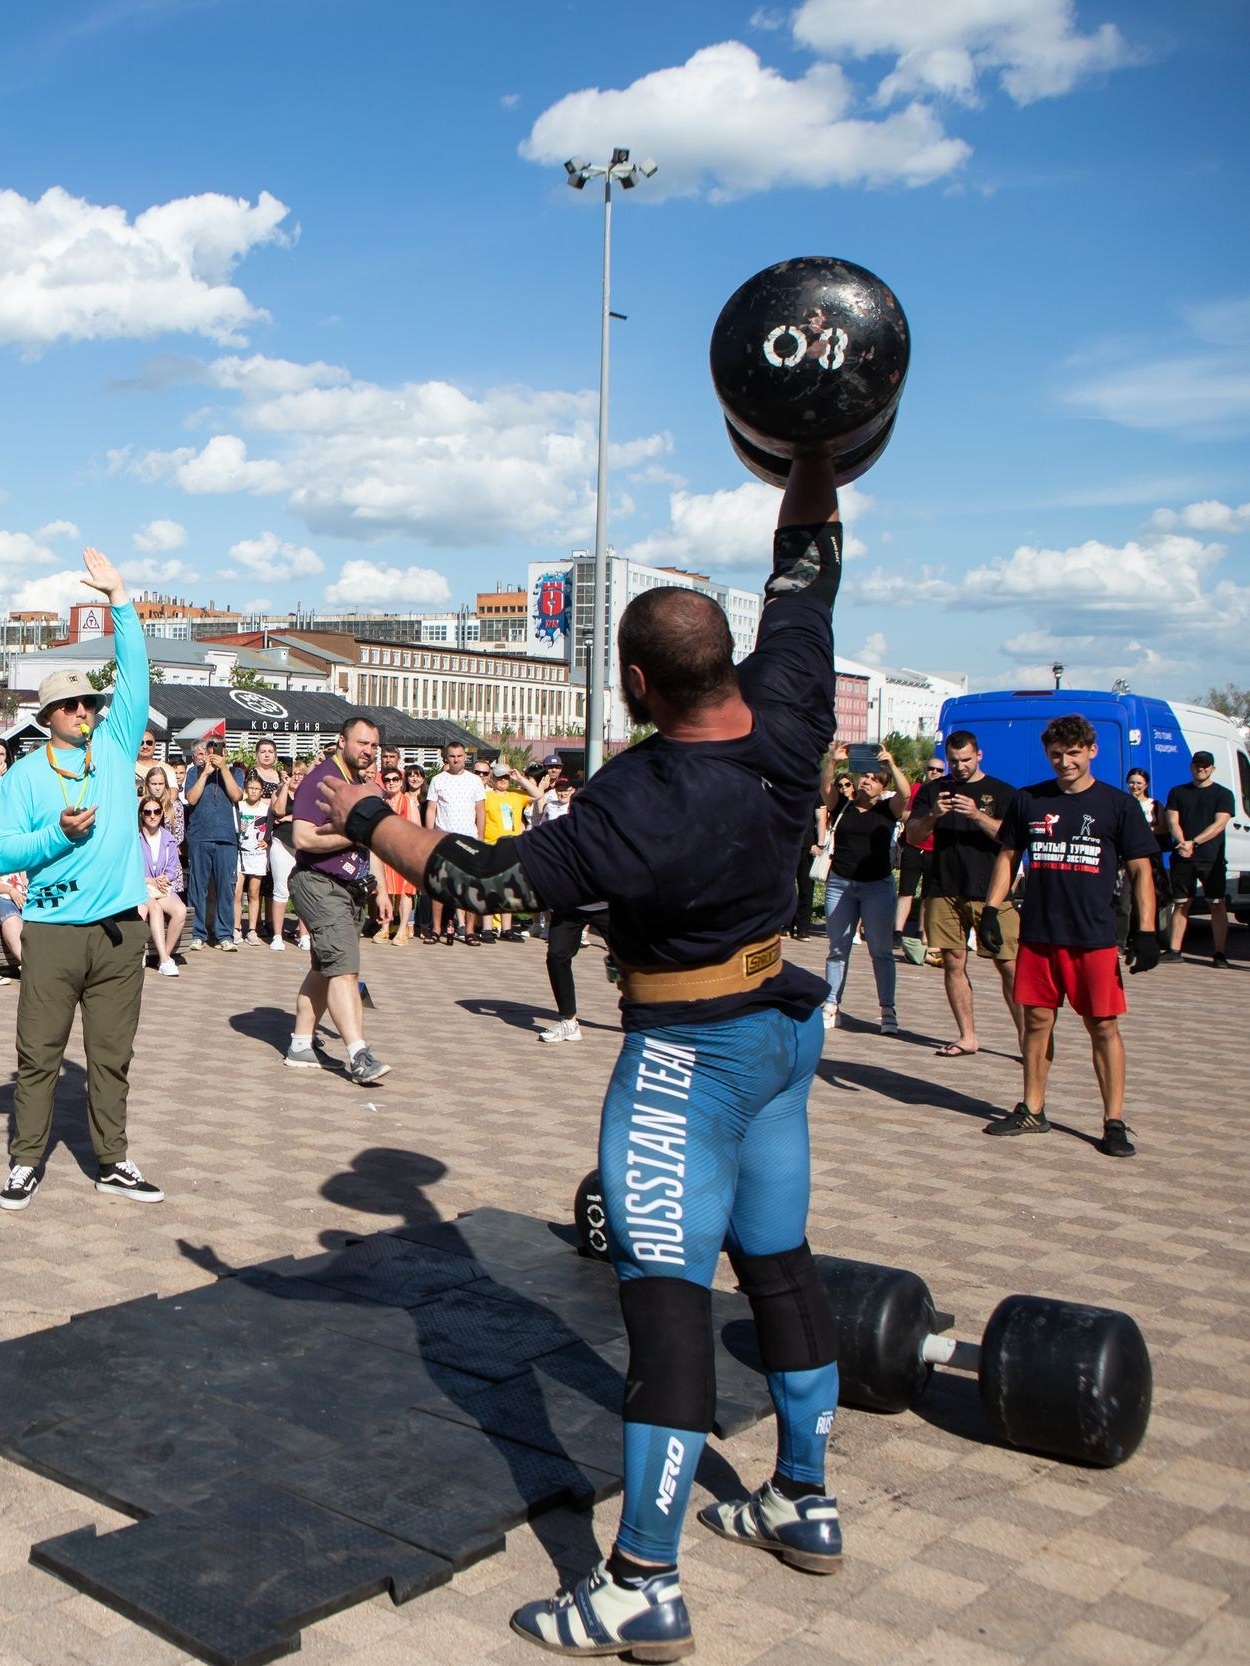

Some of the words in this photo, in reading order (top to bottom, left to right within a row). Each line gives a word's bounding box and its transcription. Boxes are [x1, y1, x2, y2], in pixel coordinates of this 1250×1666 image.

[251, 720, 320, 731] КОФЕЙНЯ
[1032, 842, 1066, 853] КРЫТЫЙ
[1070, 844, 1101, 856] ТУРНИР
[636, 1037, 697, 1101] TEAM
[624, 1103, 688, 1267] RUSSIAN
[586, 1194, 608, 1252] 100
[655, 1436, 685, 1516] NERO
